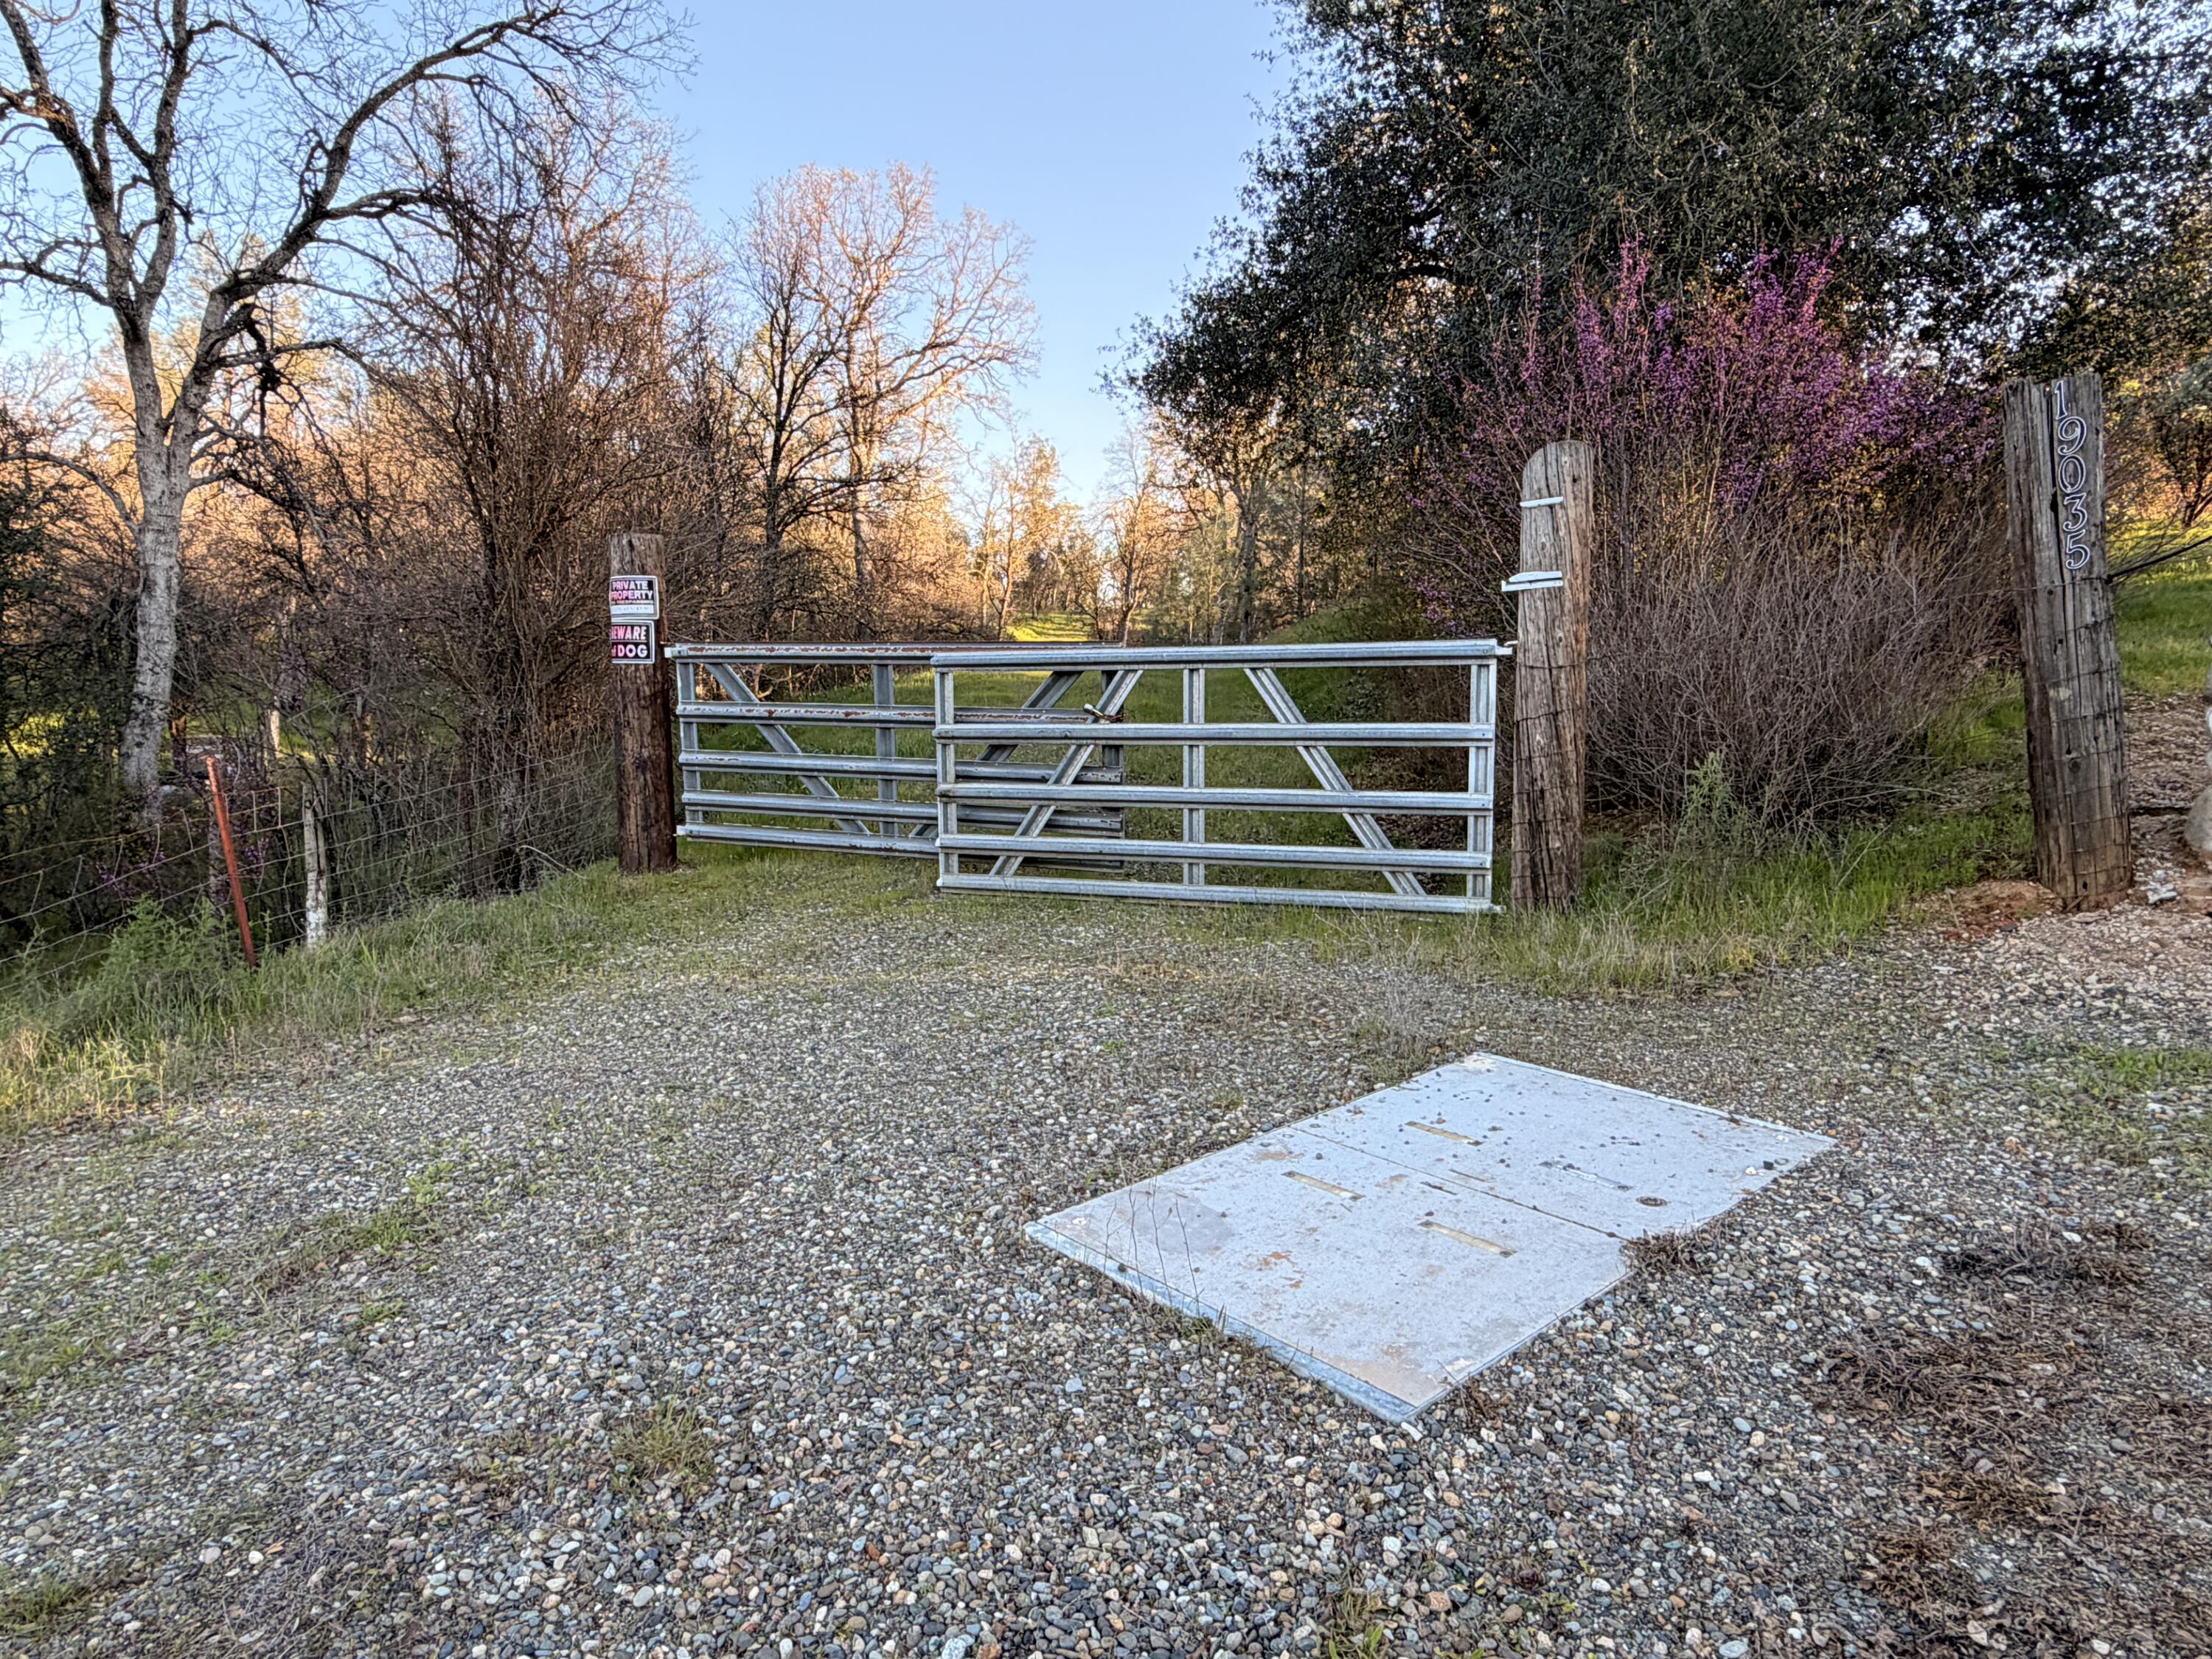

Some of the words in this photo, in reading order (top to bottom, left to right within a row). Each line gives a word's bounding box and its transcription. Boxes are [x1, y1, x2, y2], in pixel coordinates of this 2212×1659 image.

[2054, 380, 2090, 569] 19035
[612, 580, 649, 590] PRIVATE
[611, 591, 653, 600] PROPERTY
[617, 644, 648, 658] DOG
